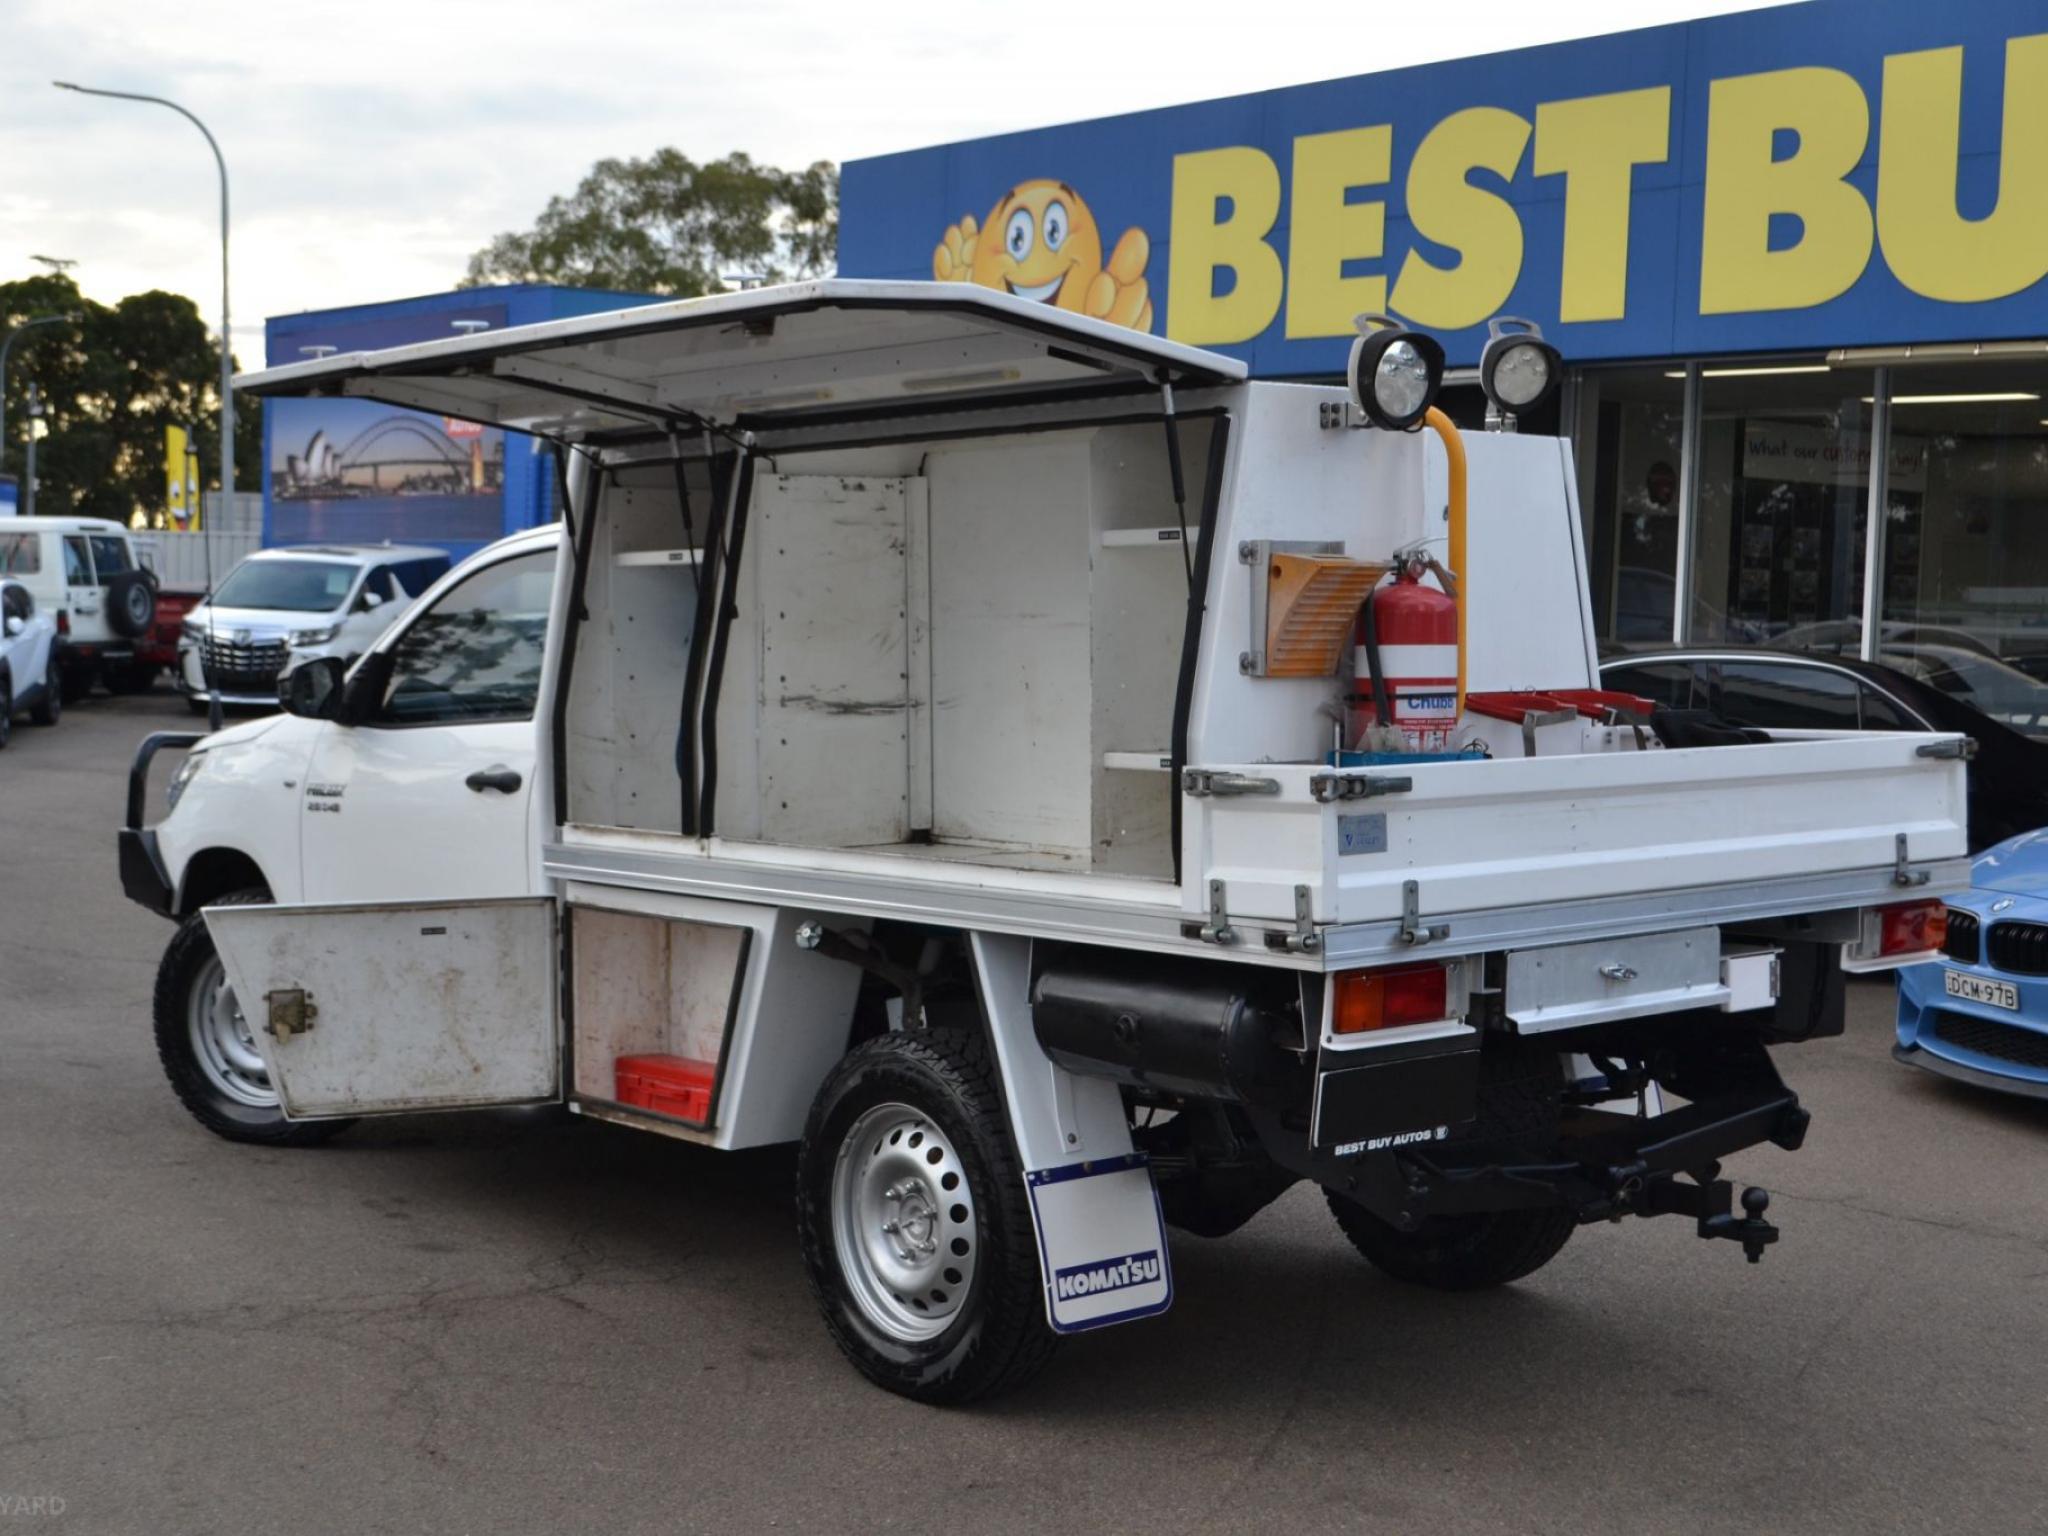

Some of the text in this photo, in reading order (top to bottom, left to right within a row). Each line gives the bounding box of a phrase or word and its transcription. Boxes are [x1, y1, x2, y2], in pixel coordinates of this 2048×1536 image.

[1167, 85, 1671, 345] BEST
[1408, 693, 1454, 710] Chubb
[1334, 1141, 1366, 1156] BEST
[1367, 1136, 1393, 1151] BUY
[1393, 1129, 1432, 1146] AUTOS
[1058, 1256, 1159, 1299] KOMATSU
